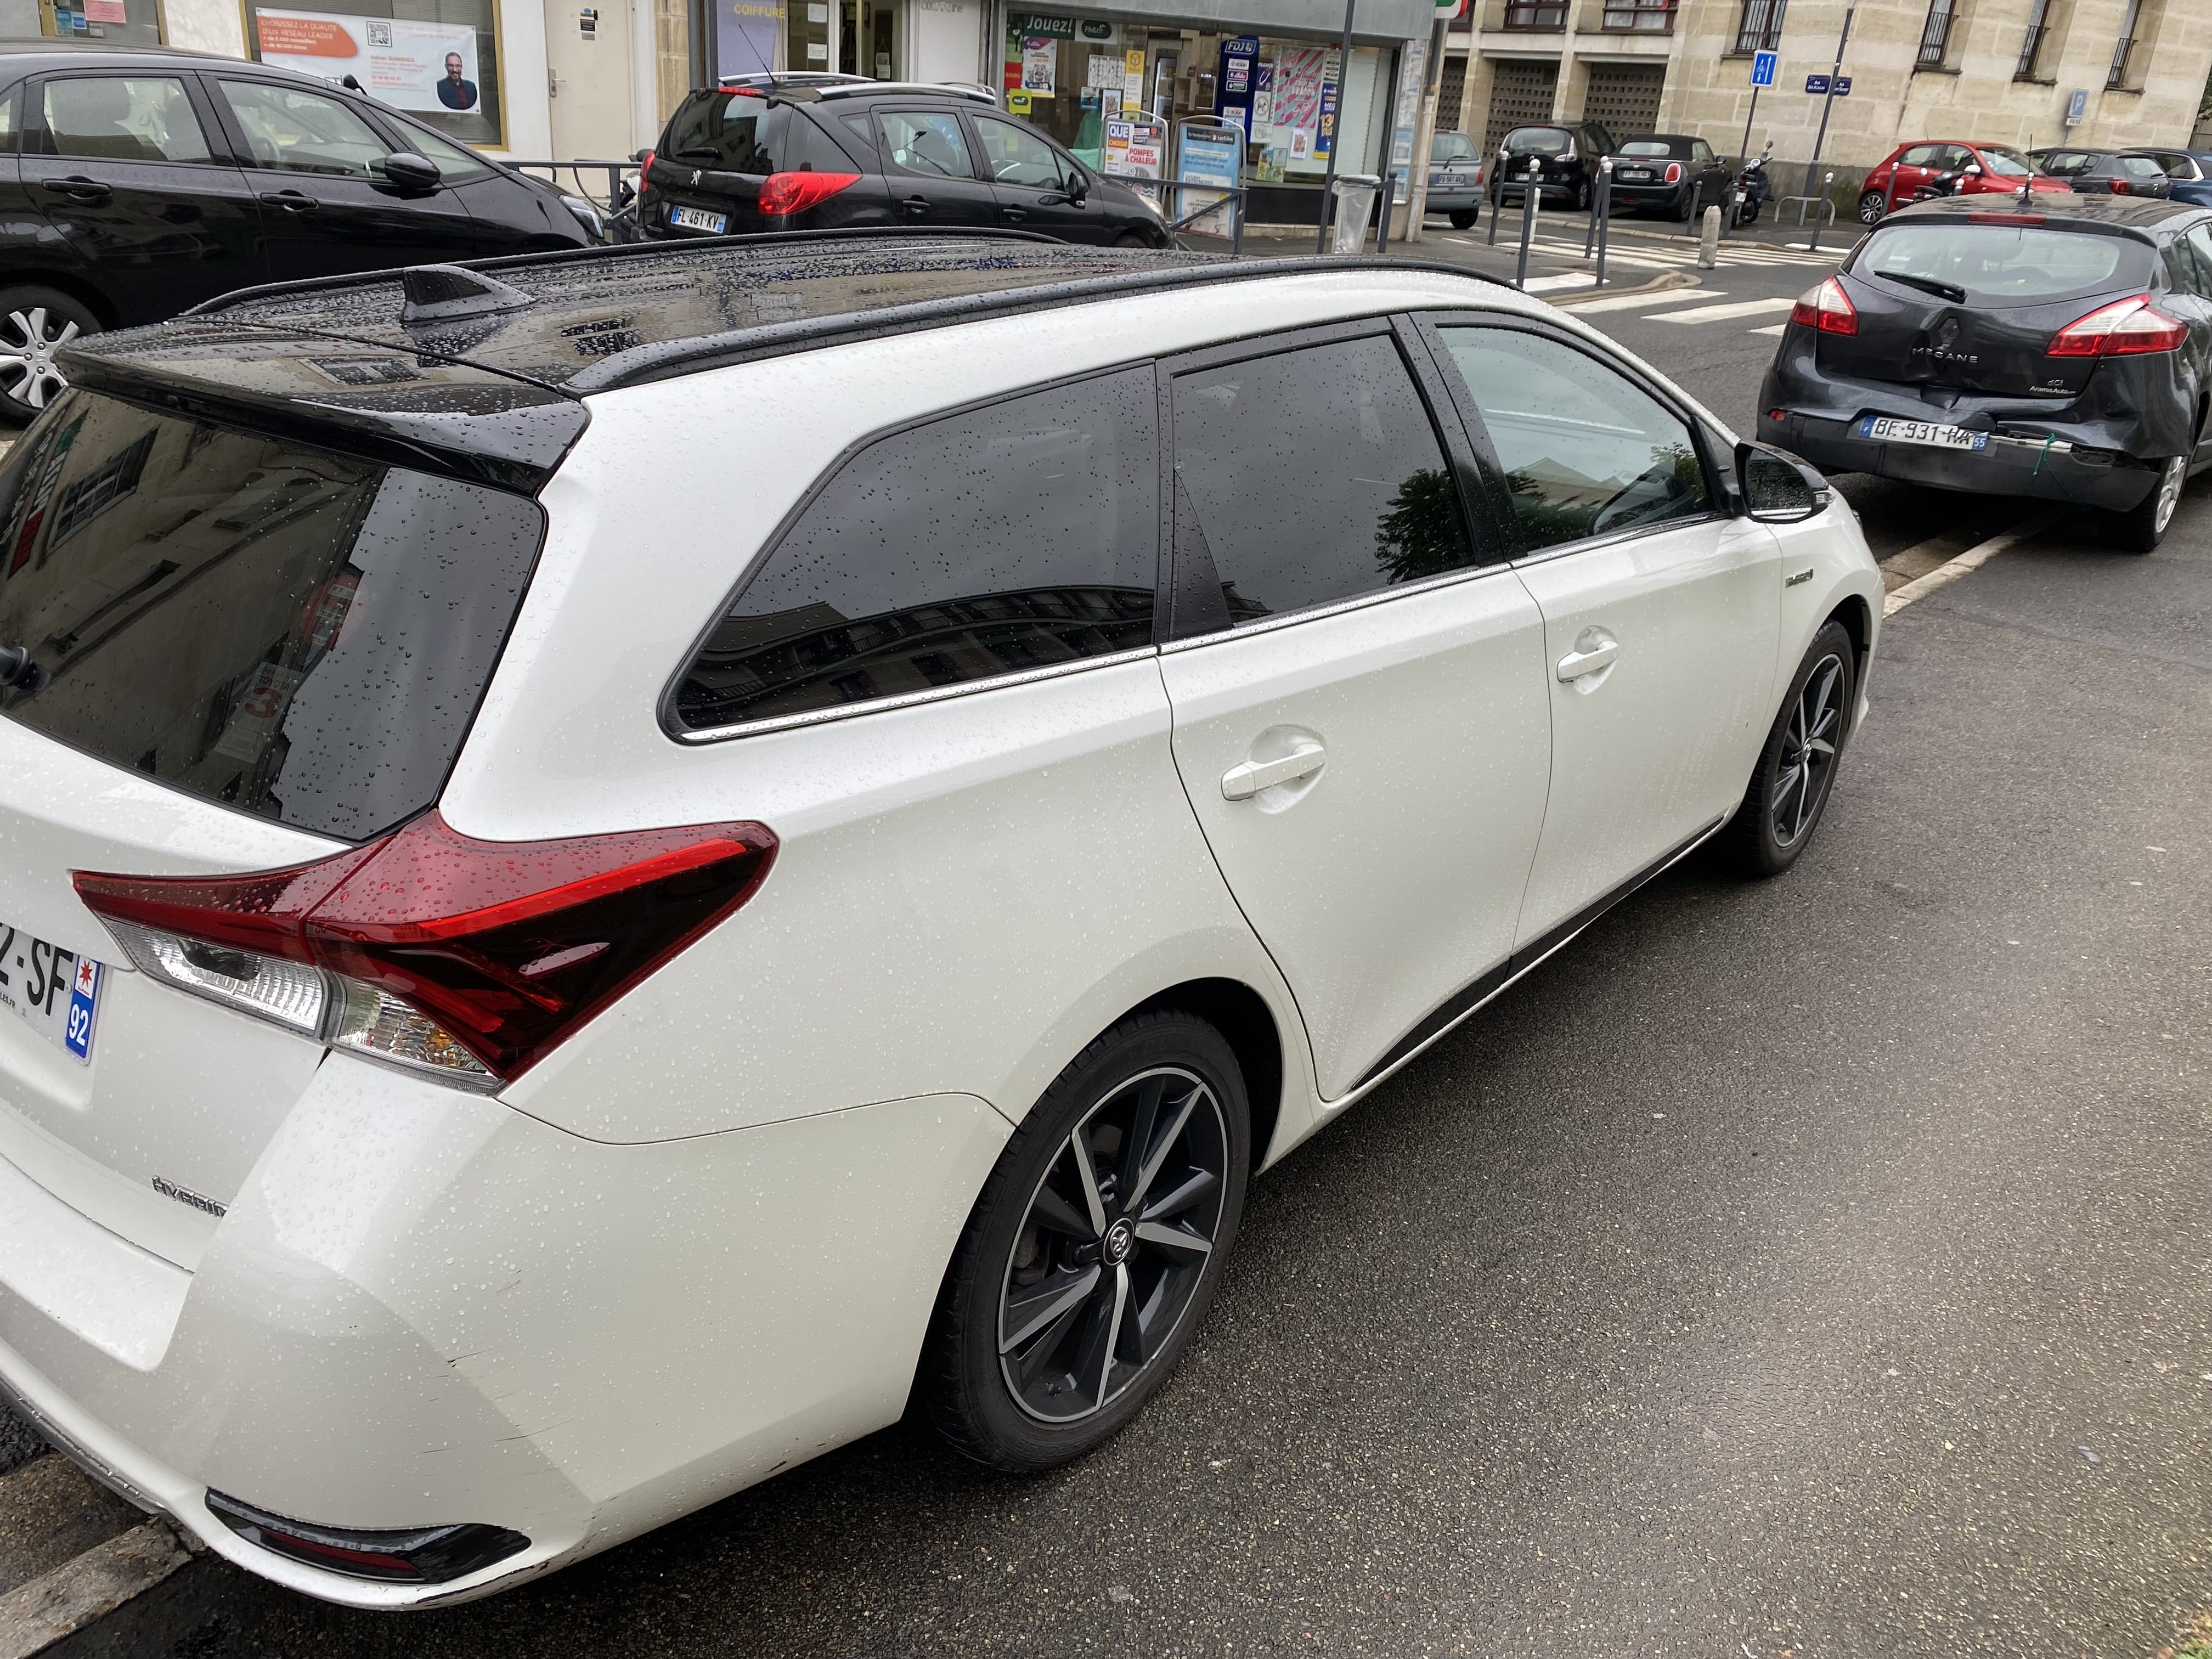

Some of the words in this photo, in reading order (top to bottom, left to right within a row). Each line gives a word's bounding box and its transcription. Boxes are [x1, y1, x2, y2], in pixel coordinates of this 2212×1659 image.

[734, 3, 786, 19] COIFFURE
[261, 19, 298, 28] CHOISISSEZ
[1027, 15, 1073, 33] Jouez!
[1084, 25, 1099, 33] PMU
[1228, 41, 1245, 52] FDJ
[1291, 86, 1316, 97] DRAGON
[2075, 94, 2084, 112] P
[1109, 125, 1128, 138] QUE
[1125, 154, 1129, 162] À
[1130, 156, 1157, 165] CHALEUR
[1129, 148, 1154, 157] POMPES
[676, 208, 720, 229] FL-461-KV
[1912, 347, 1978, 363] MEGANE
[1974, 437, 1986, 447] 55
[259, 675, 290, 691] TOYOTA
[245, 687, 282, 718] 3
[69, 1003, 89, 1047] 92
